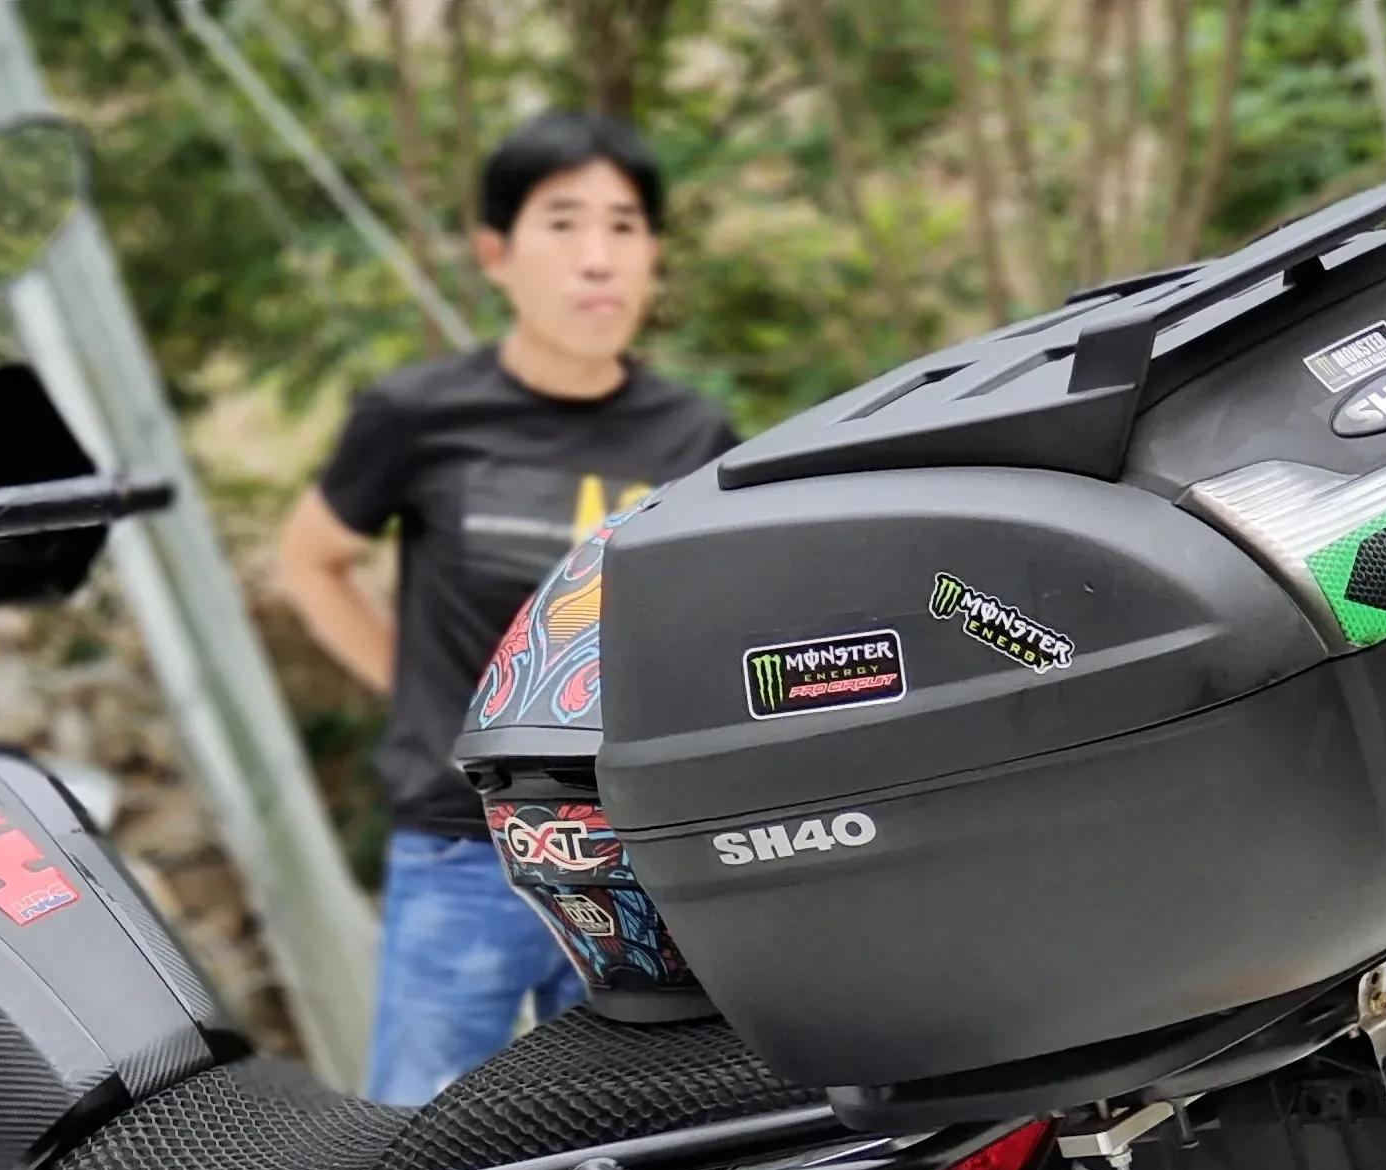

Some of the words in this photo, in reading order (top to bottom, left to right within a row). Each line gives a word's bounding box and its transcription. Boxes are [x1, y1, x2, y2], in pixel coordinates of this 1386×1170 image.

[961, 591, 1070, 663] MONSTER
[969, 620, 1050, 668] ENERGY
[785, 641, 894, 672] MONSTER
[804, 664, 880, 682] ENERGY
[505, 818, 597, 867] GXT
[712, 811, 877, 866] SH40
